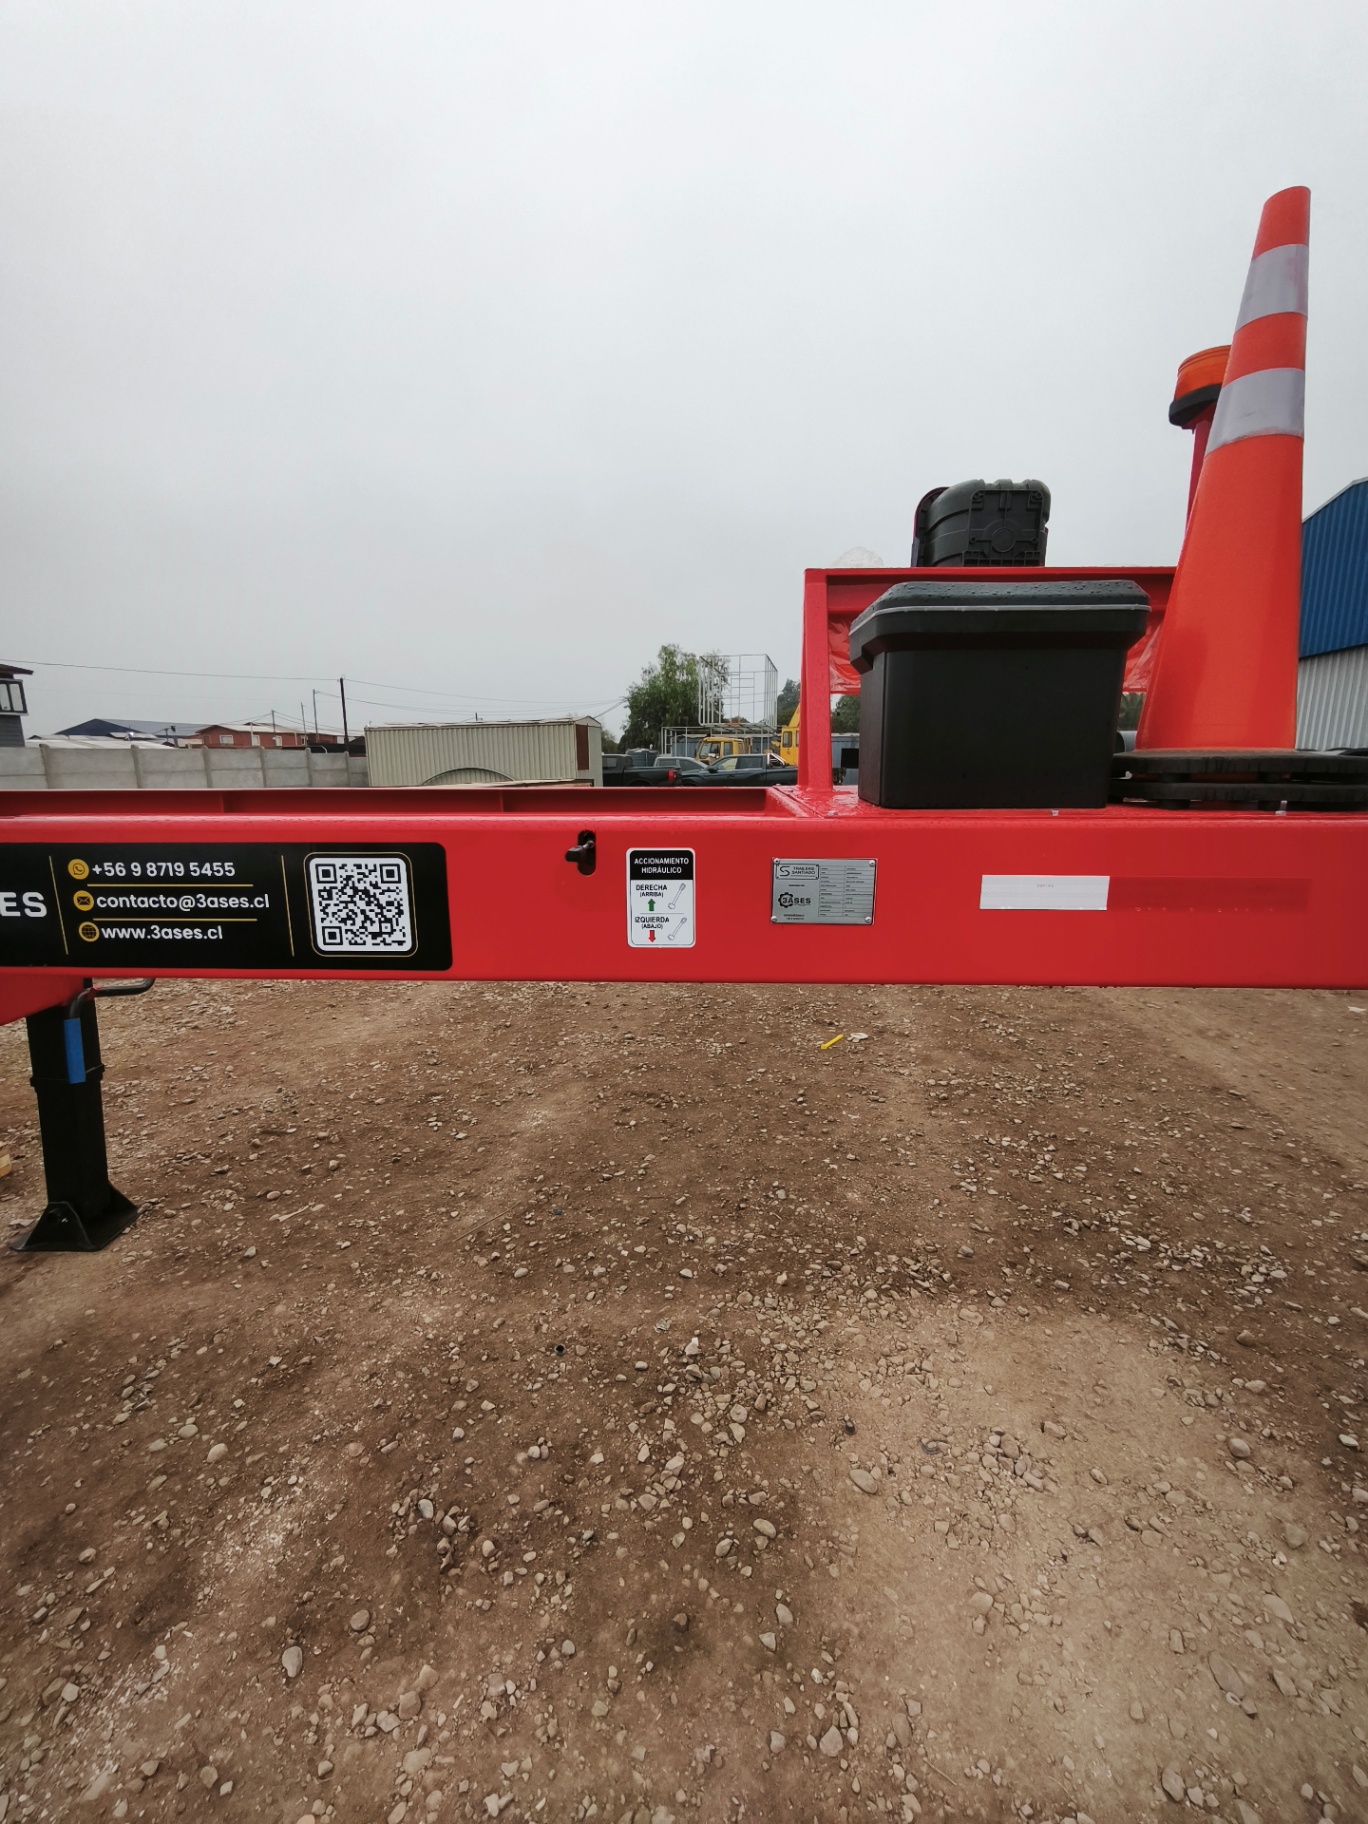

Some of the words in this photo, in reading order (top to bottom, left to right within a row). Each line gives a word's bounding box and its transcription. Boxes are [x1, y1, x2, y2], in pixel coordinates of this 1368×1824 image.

[92, 862, 126, 877] +56
[131, 862, 141, 877] 9
[146, 862, 185, 877] 8719
[189, 862, 236, 877] 5455
[641, 865, 682, 874] HIDRÁULICO
[0, 891, 48, 918] ES
[96, 894, 270, 912] contacto@3ases.cl
[101, 924, 223, 940] www.3ases.cl
